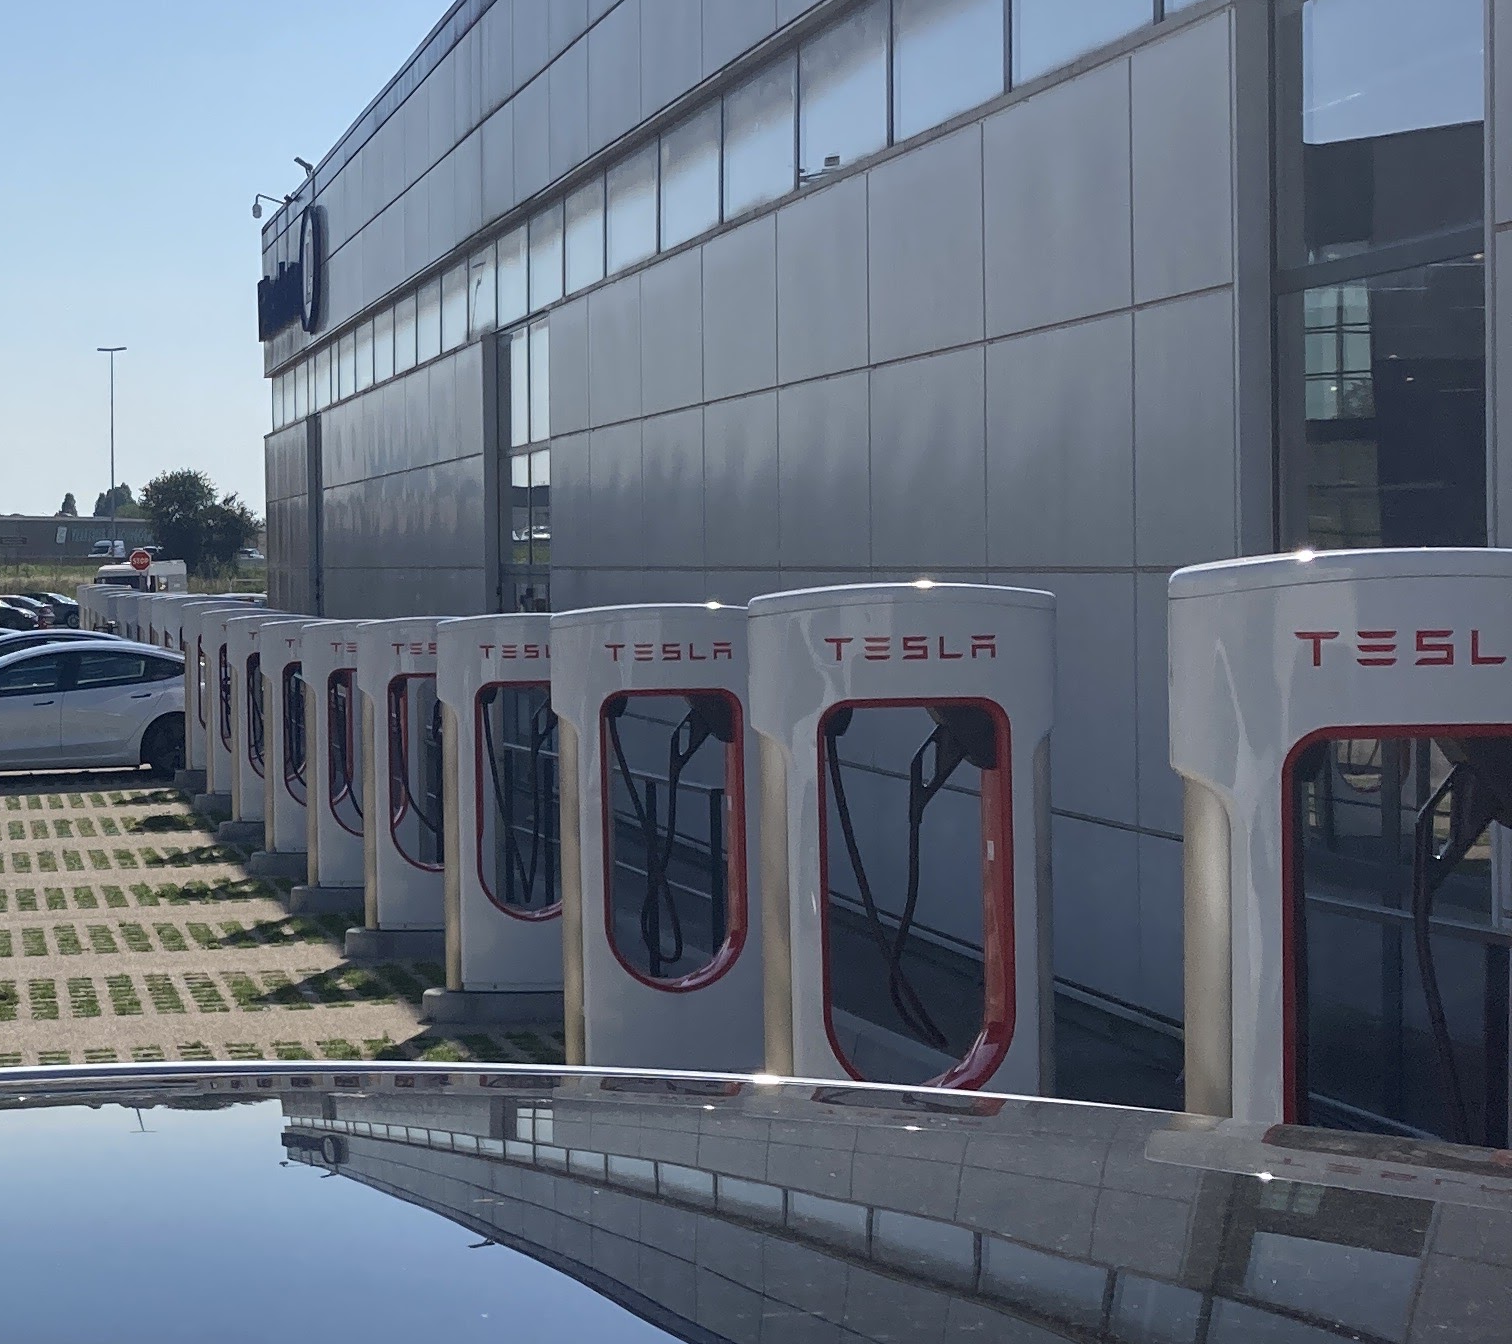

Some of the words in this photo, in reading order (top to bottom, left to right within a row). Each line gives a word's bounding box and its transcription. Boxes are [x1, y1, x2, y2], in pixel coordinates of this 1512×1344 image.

[132, 557, 149, 565] STOP
[391, 642, 437, 655] TES
[479, 644, 551, 659] TESL
[604, 642, 732, 662] TESLA
[824, 635, 996, 661] TESLA
[1294, 630, 1507, 666] TESL
